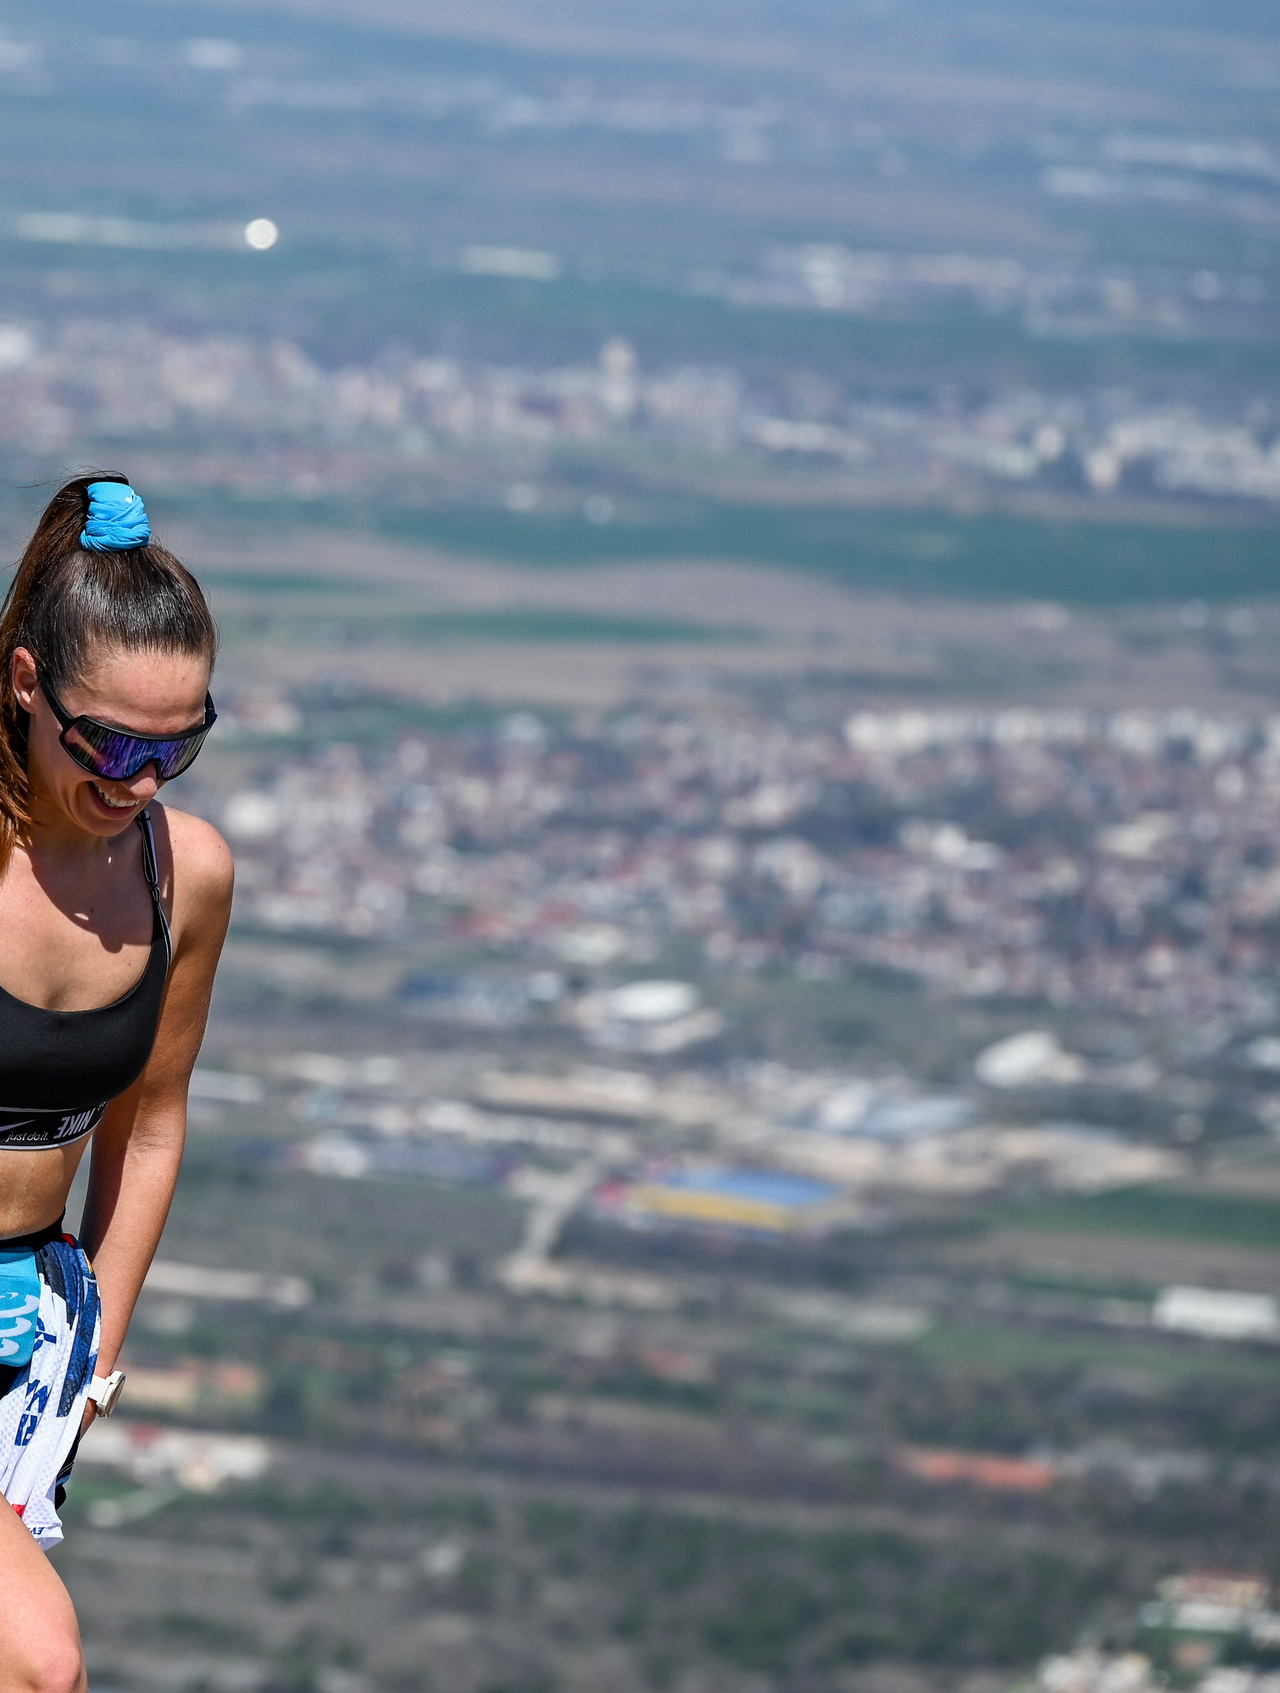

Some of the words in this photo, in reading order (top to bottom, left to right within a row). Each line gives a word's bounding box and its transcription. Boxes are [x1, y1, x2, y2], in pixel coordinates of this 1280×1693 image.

[53, 1107, 96, 1140] NIKE
[5, 1131, 26, 1143] just
[27, 1131, 40, 1141] do
